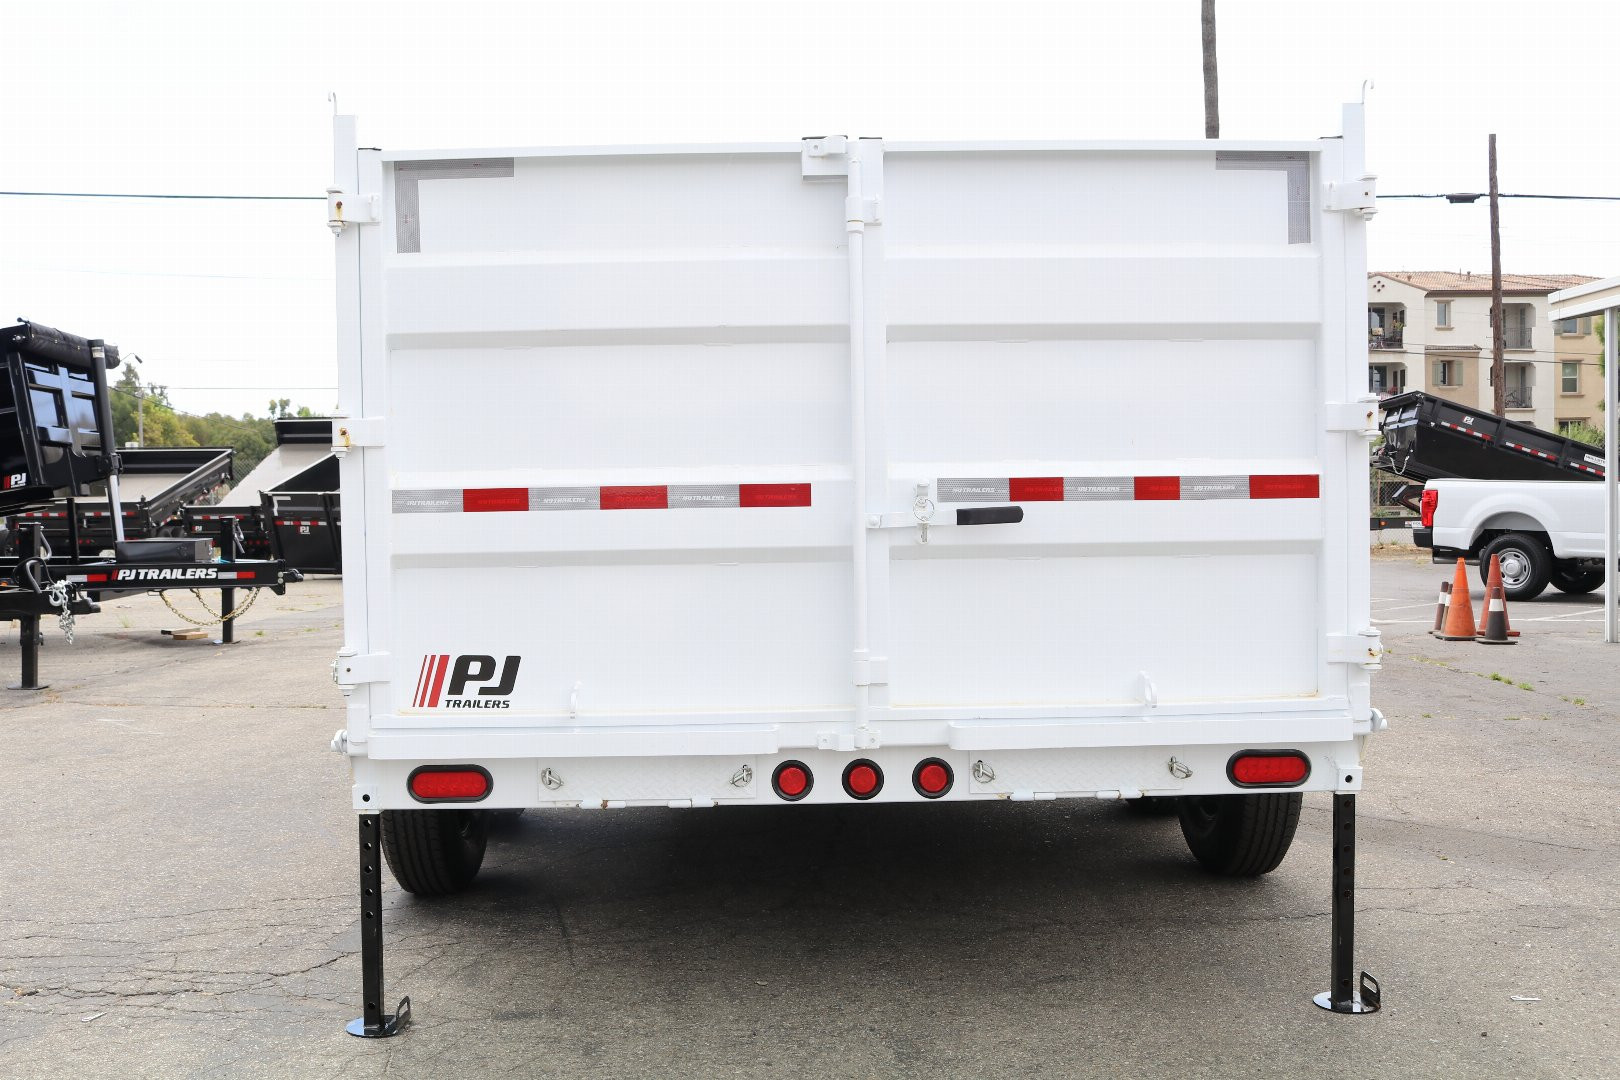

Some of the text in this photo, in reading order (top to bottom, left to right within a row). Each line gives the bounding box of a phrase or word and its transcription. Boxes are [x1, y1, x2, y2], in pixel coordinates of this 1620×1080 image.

[11, 473, 26, 486] PJ
[117, 568, 218, 580] PJ TRAILERS
[448, 655, 521, 695] PJ
[445, 700, 510, 708] TRAILERS
